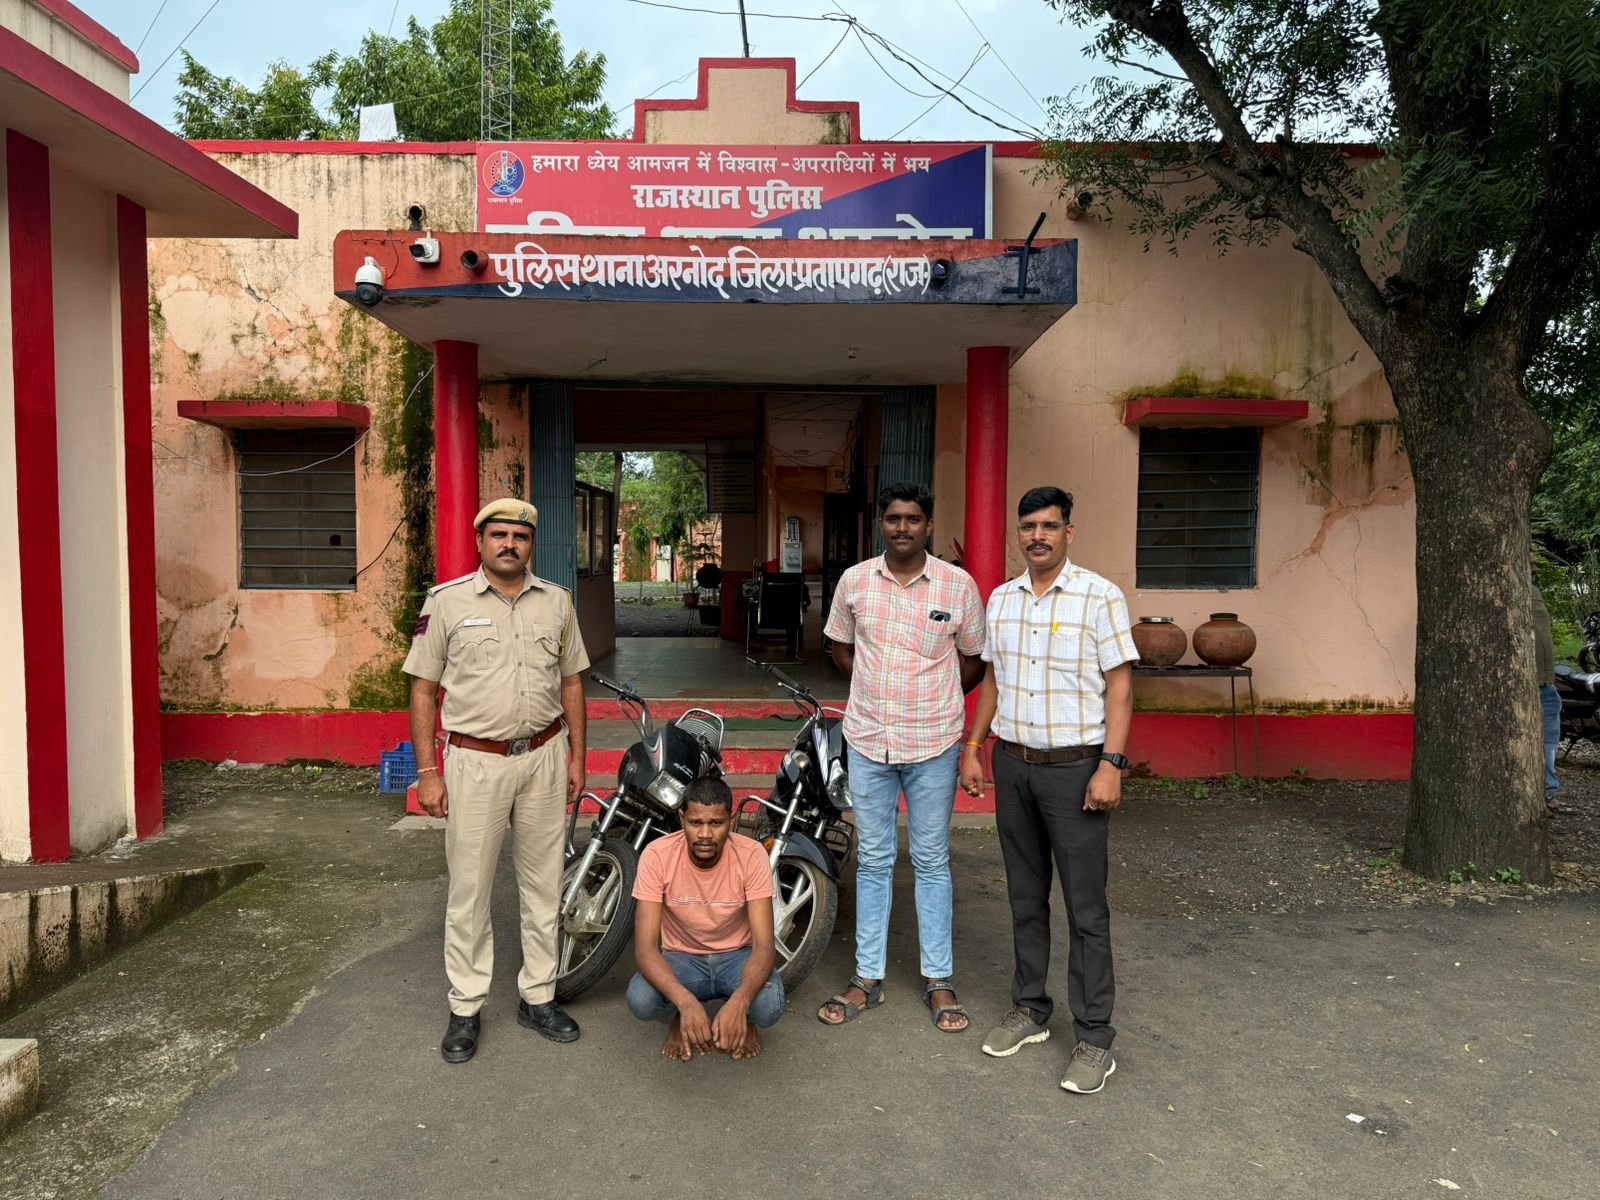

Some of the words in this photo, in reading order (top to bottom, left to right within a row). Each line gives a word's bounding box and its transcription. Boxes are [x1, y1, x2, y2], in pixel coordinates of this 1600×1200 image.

[530, 153, 580, 174] हमारा
[586, 150, 621, 172] ध्येय
[626, 154, 691, 174] आमजन
[696, 150, 712, 174] में
[880, 151, 897, 174] में
[903, 156, 932, 174] भय
[629, 184, 742, 210] राजस्थान
[745, 179, 824, 219] पुलिस
